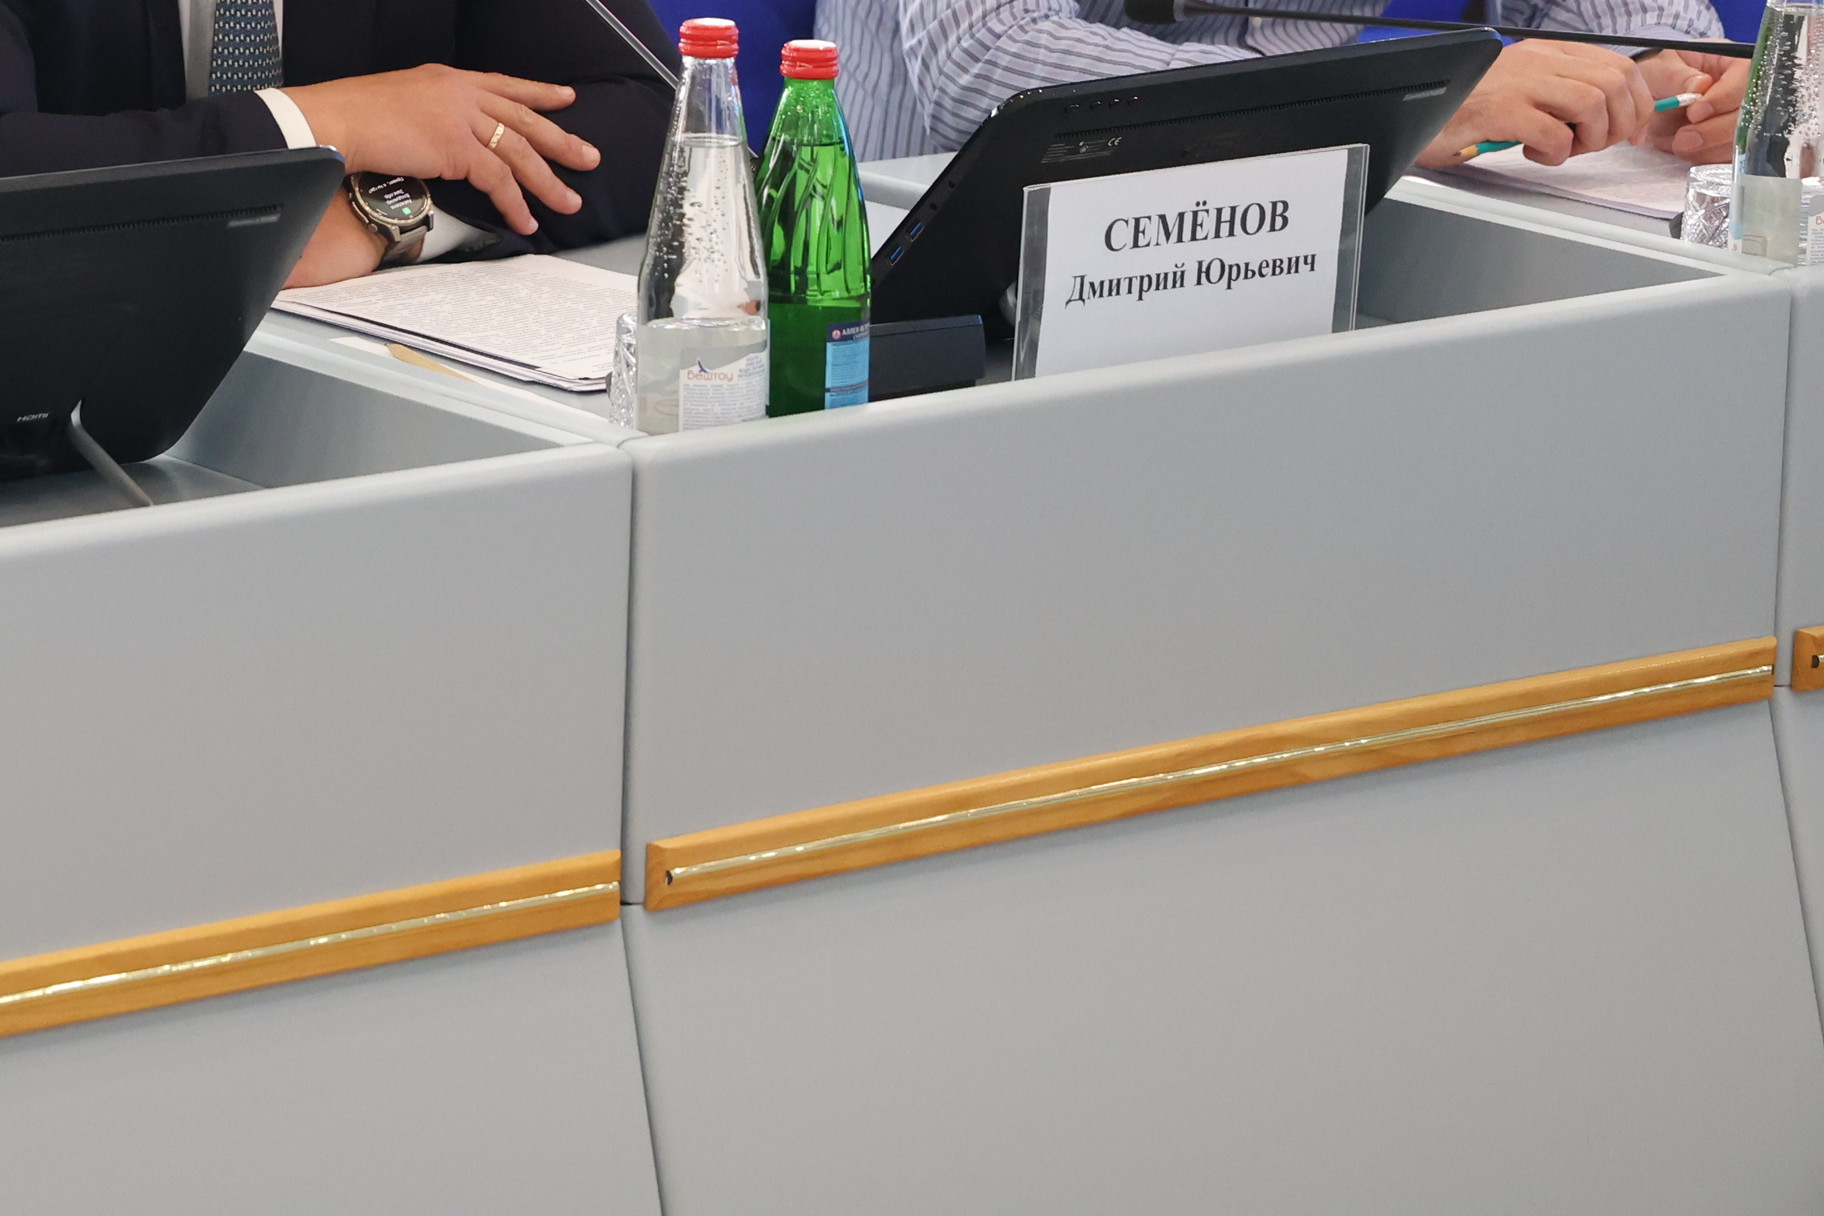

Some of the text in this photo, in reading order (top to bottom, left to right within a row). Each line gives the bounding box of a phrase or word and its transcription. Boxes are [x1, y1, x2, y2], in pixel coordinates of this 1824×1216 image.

[1103, 199, 1291, 252] СЕМЁНОВ
[1064, 253, 1318, 307] Дмитрий Юрьевич
